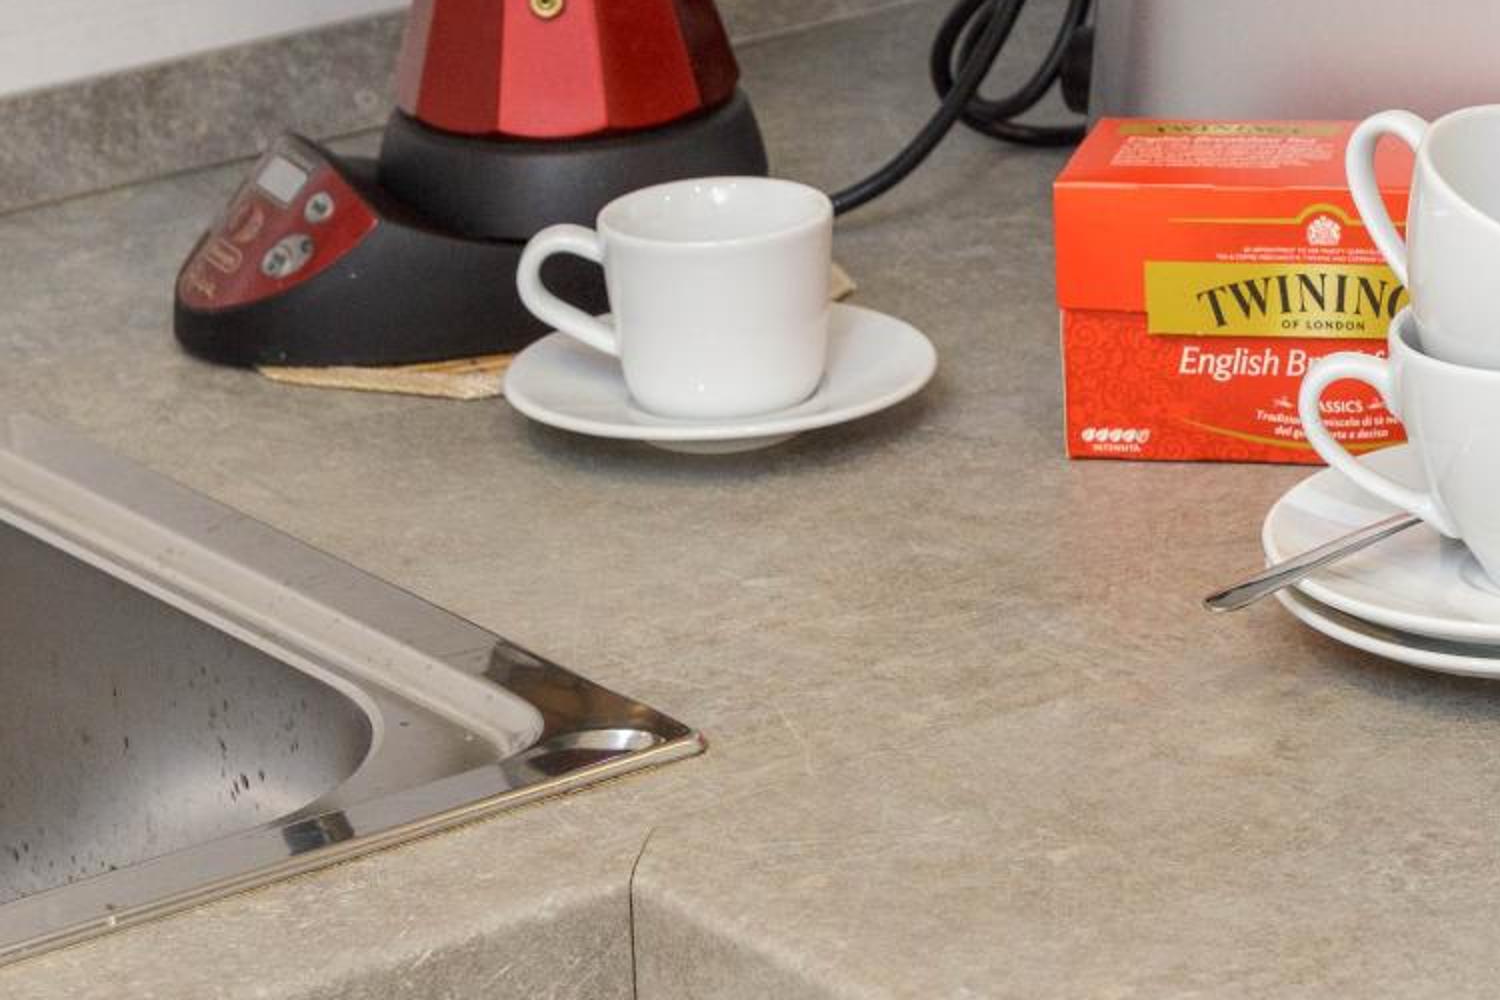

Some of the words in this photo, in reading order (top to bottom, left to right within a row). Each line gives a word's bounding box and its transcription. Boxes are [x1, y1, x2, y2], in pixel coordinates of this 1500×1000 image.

[1281, 319, 1299, 331] OF
[1305, 319, 1366, 332] LONDON
[1179, 346, 1279, 381] English
